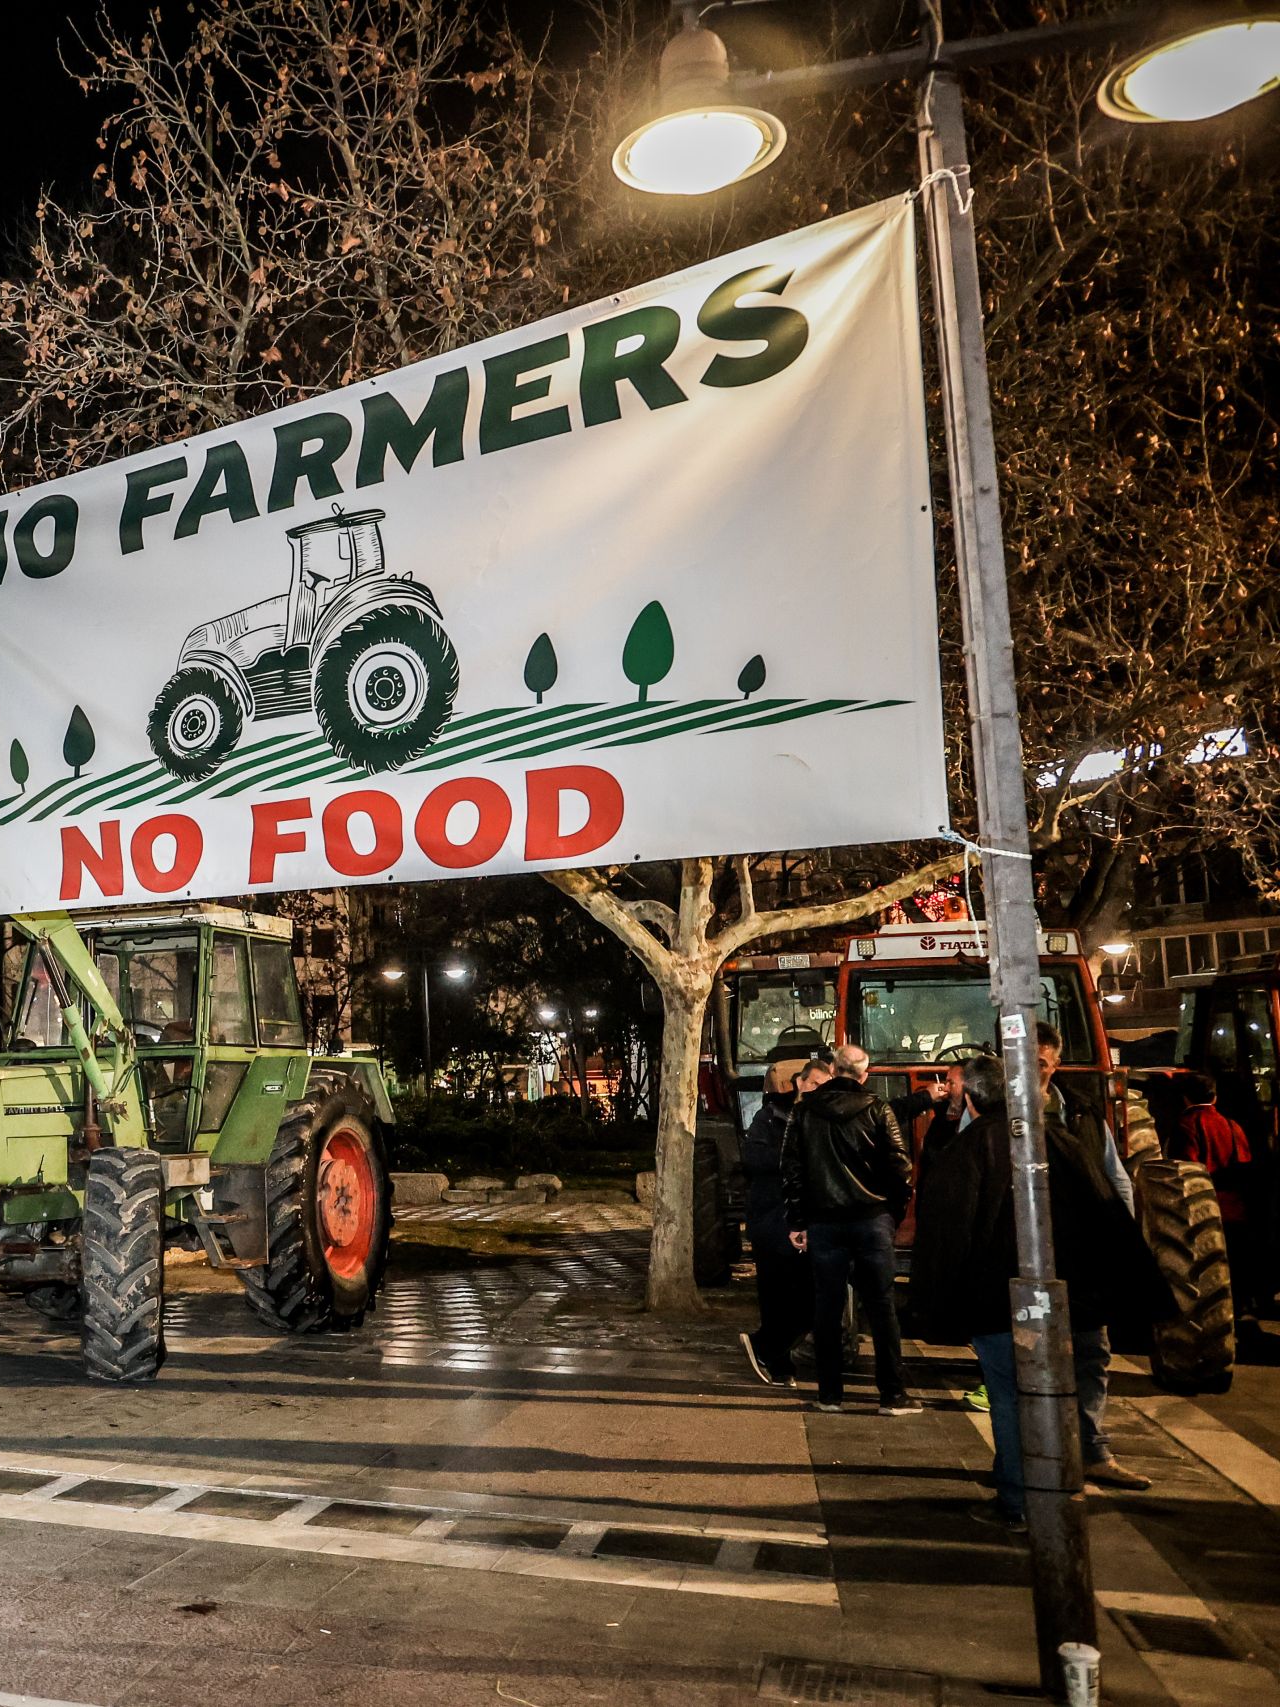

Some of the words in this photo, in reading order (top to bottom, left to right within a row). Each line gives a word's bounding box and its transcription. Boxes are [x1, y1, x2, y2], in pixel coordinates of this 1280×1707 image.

[119, 264, 810, 555] FARMERS
[59, 814, 203, 901] NO
[249, 765, 625, 885] FOOD
[940, 940, 989, 950] FIATAG
